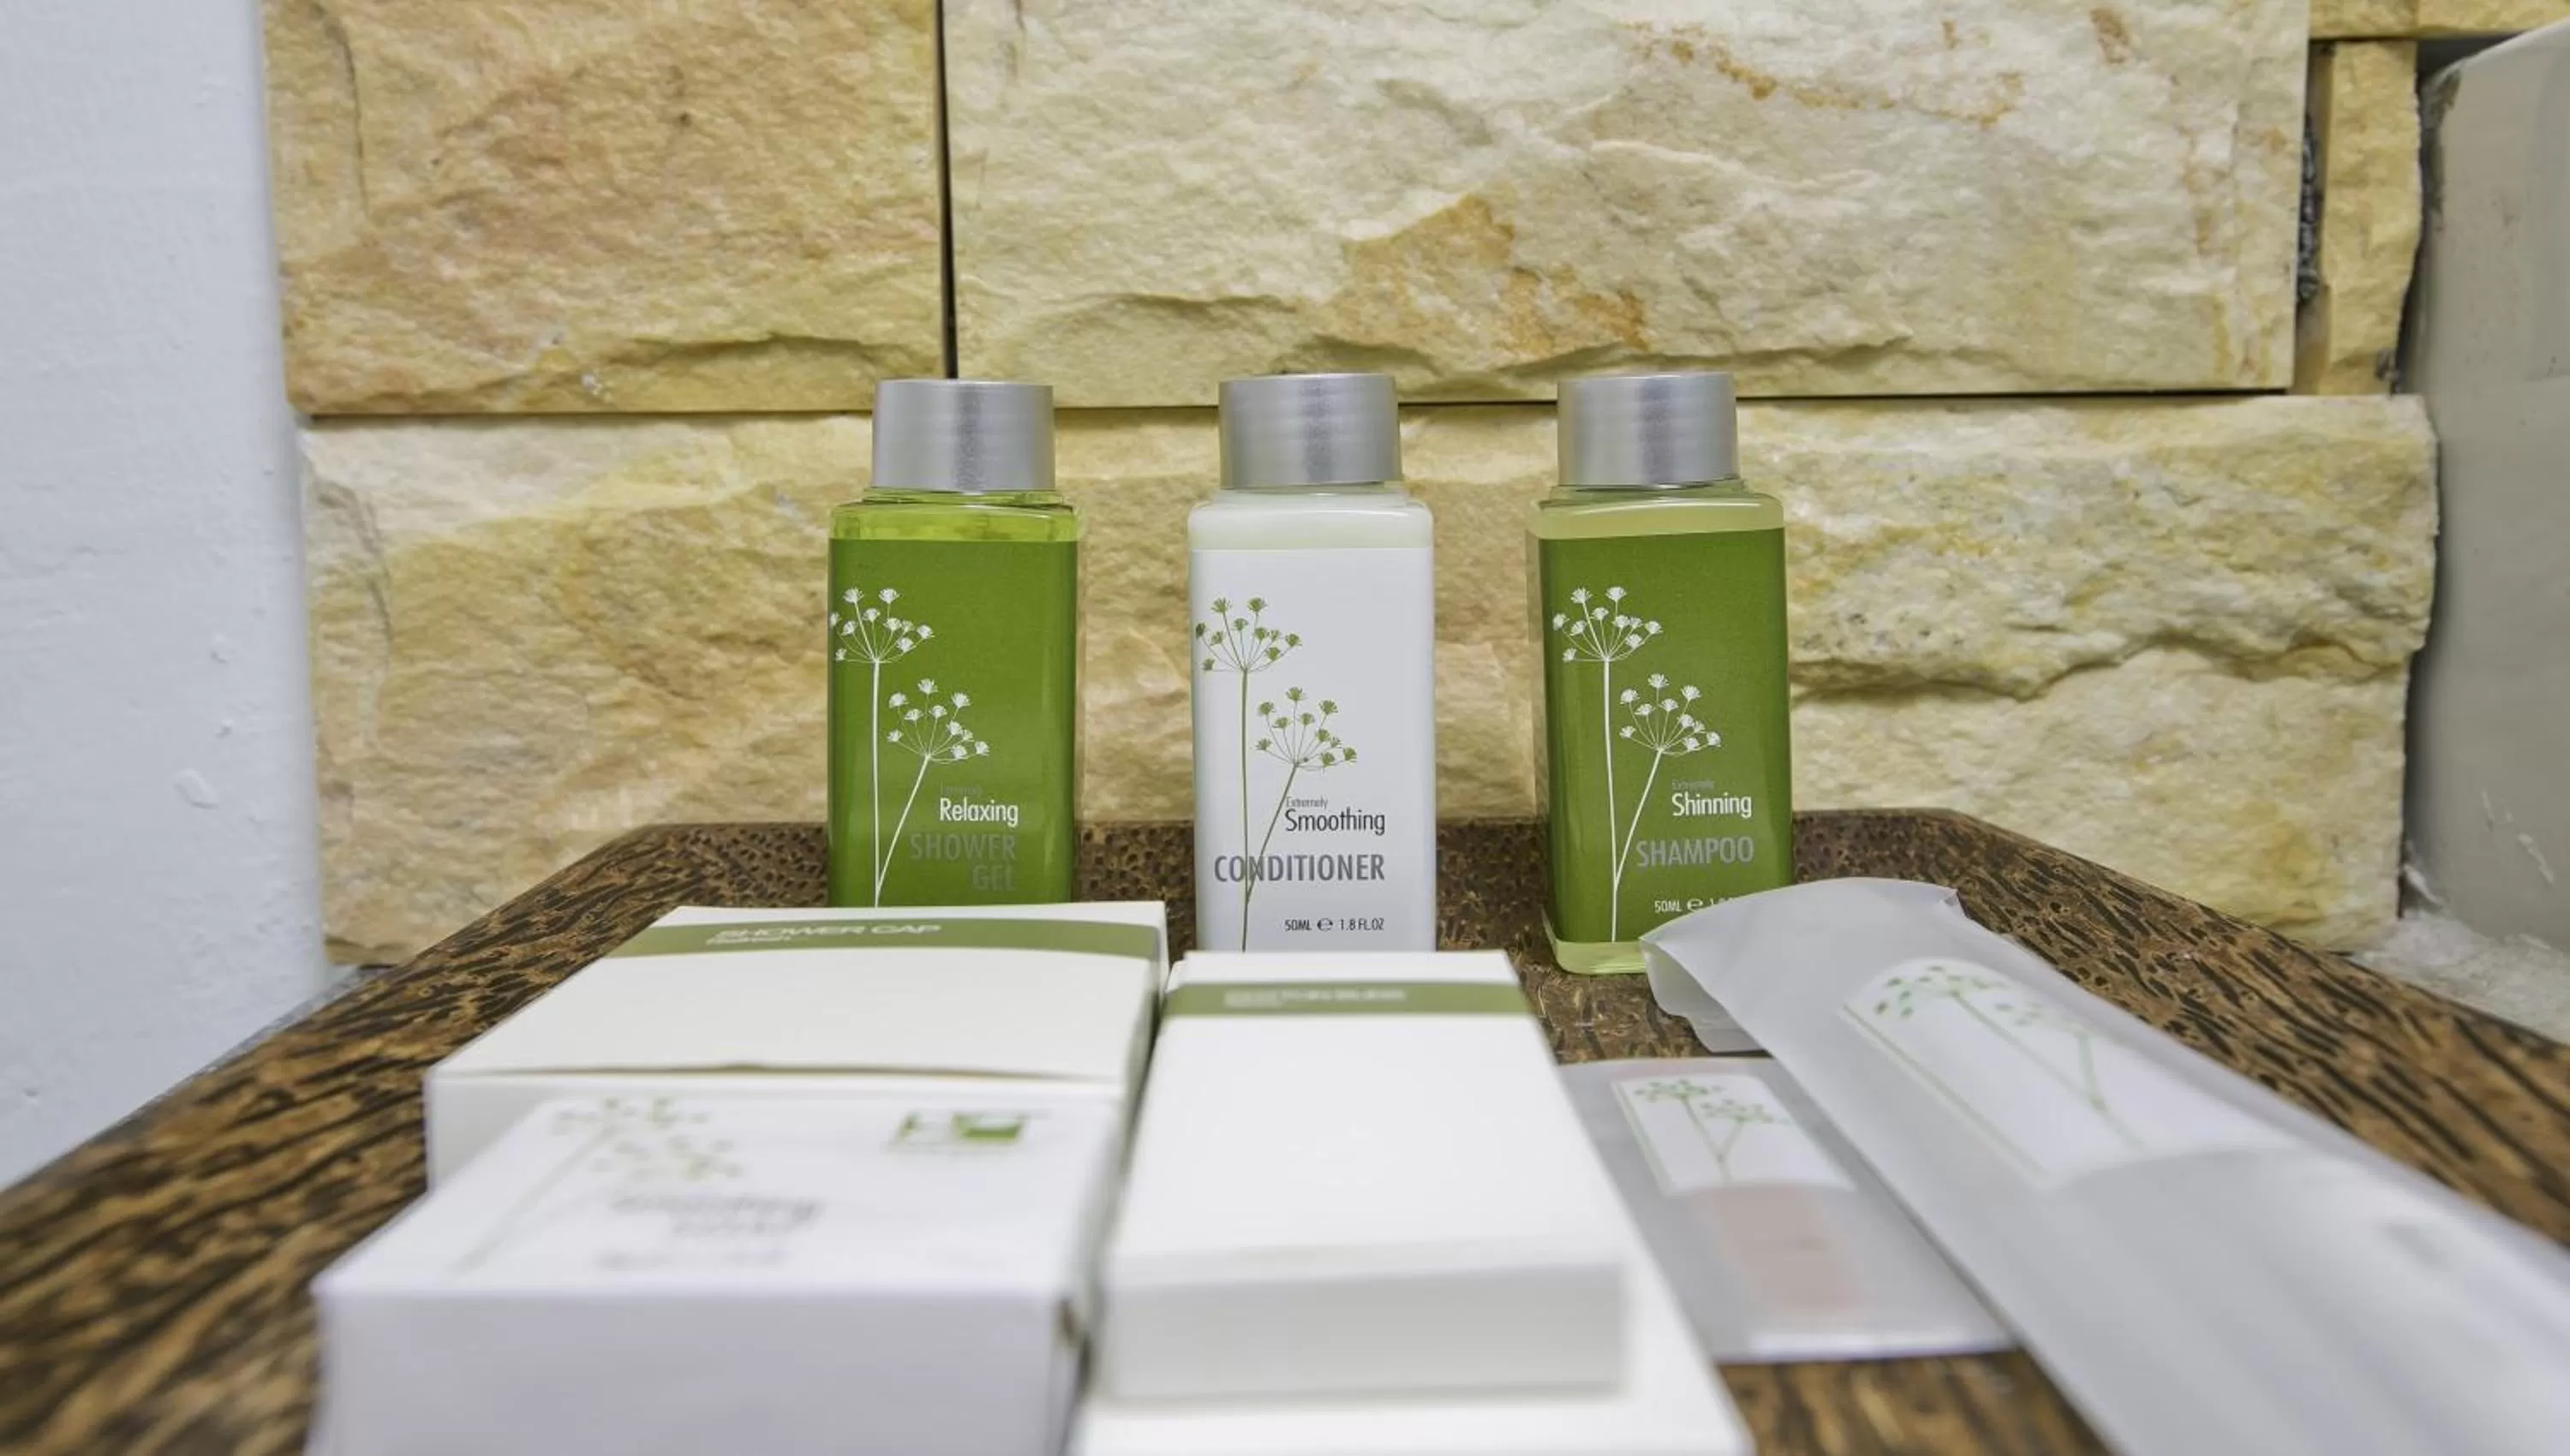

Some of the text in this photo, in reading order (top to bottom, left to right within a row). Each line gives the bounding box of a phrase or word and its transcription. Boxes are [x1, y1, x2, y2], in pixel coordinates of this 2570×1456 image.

[940, 797, 1019, 827] Relaxing
[1671, 791, 1752, 819] Shinning
[1284, 807, 1385, 836] Smoothing
[911, 833, 1016, 860] SHOWER
[1636, 836, 1754, 868] SHAMPOO
[972, 864, 1016, 892] GEL
[1214, 854, 1385, 882] CONDITIONER
[1654, 899, 1683, 914] 50ML
[1285, 919, 1312, 932] 50ML
